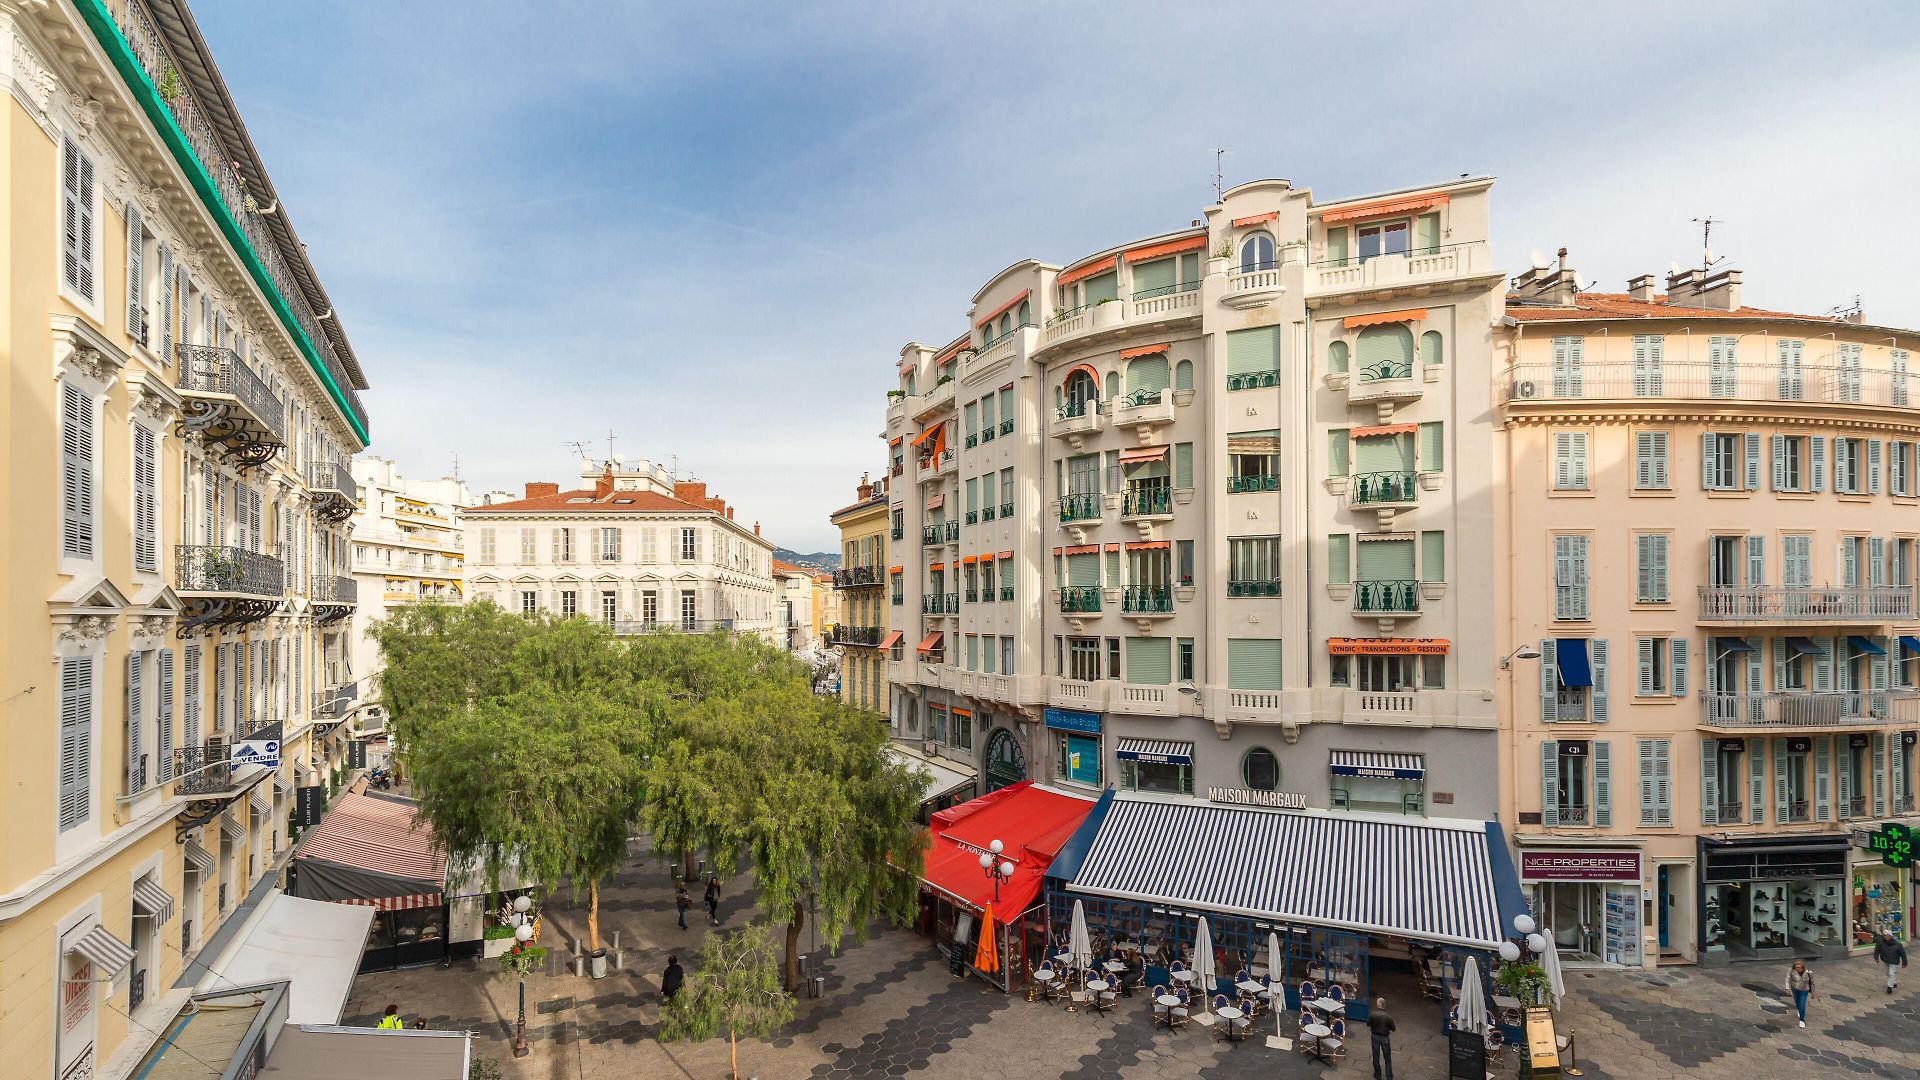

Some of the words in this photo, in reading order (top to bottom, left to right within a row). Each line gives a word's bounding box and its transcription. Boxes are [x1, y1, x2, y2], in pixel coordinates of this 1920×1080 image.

[241, 753, 278, 762] VENDRE
[1374, 769, 1395, 777] MARGAUX
[1208, 786, 1250, 804] MAISON
[1253, 790, 1307, 809] MARGAUX
[1872, 836, 1911, 854] 10:42
[1525, 858, 1552, 866] NICE
[1553, 858, 1636, 867] PROPERTIES
[64, 960, 91, 1005] DIESEL
